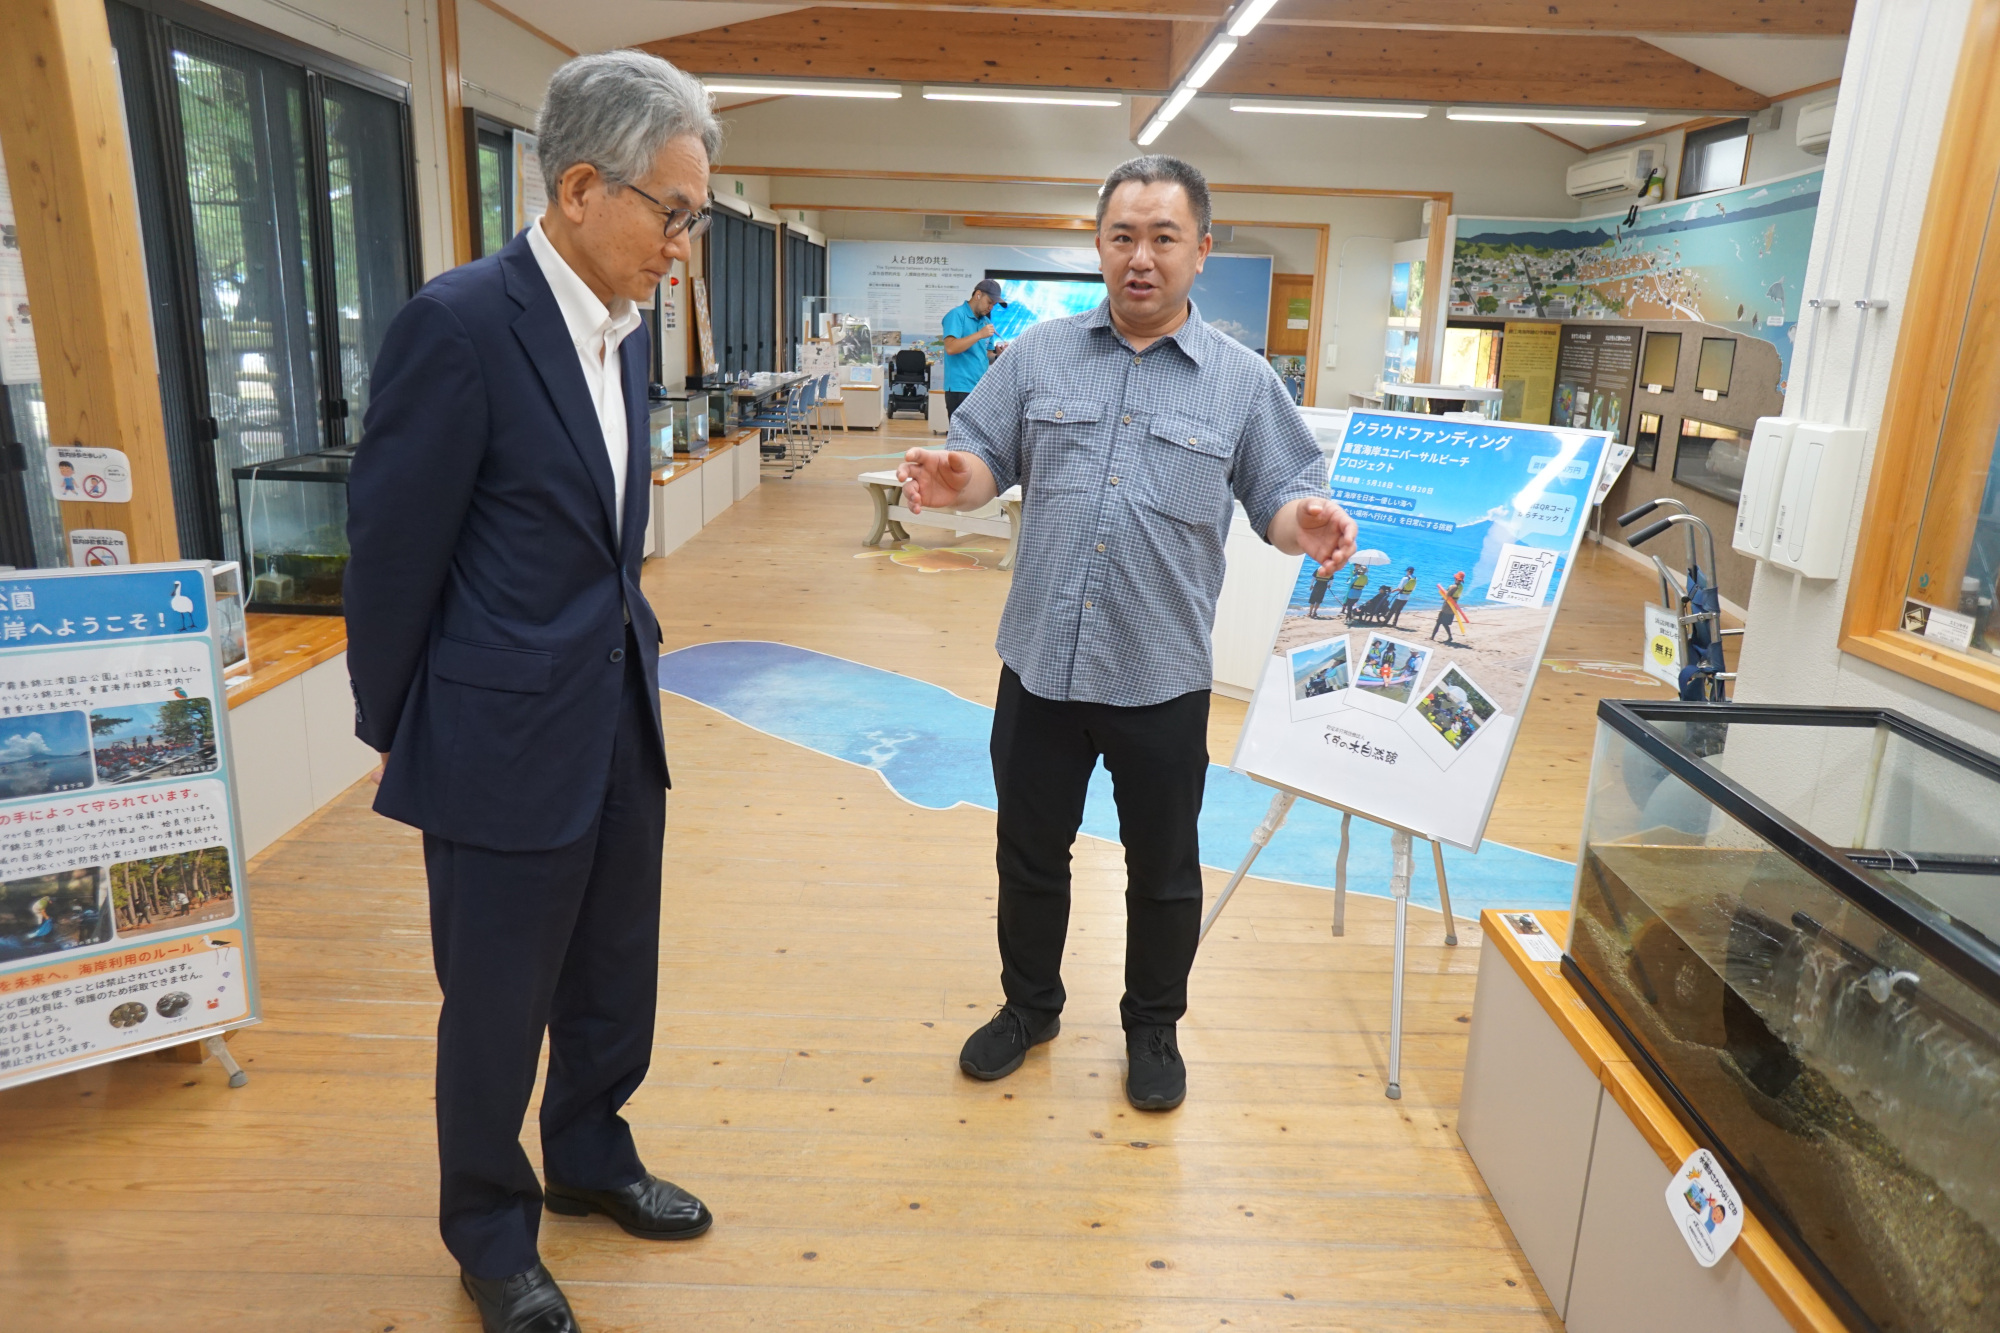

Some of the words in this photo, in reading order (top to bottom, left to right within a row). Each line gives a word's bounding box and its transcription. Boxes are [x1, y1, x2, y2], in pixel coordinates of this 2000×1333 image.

[891, 255, 949, 265] 人と自然の共生
[1276, 363, 1306, 372] HELLO
[1353, 421, 1513, 451] クラウドファンディング
[1339, 457, 1395, 473] プロジェクト
[1342, 442, 1470, 467] 重富海岸ユニバーサルビーチ
[0, 611, 166, 641] 岸へようこそ！
[1655, 642, 1673, 659] 無料
[0, 788, 199, 826] の手によって守られています。
[0, 943, 194, 992] を未来へ。海岸利用のルール
[1, 1041, 96, 1070] 禁止されています。
